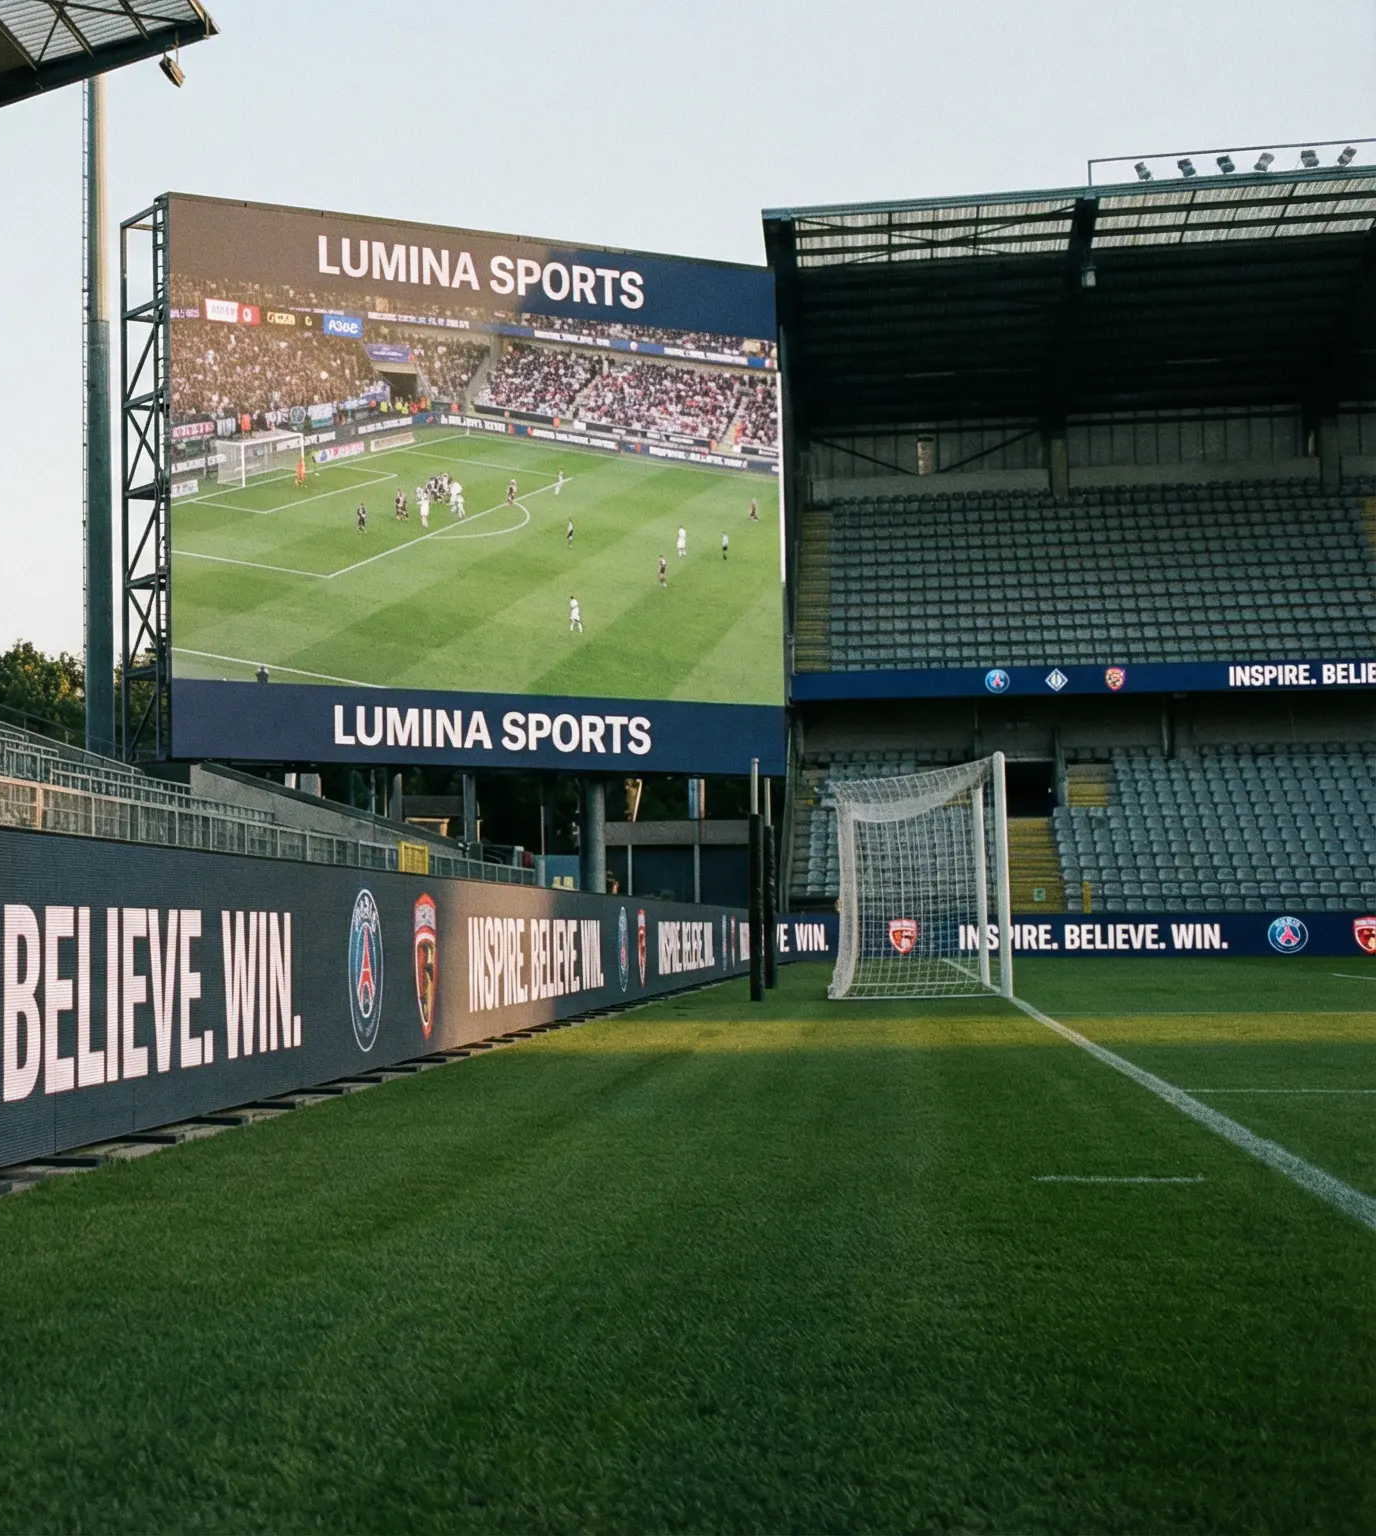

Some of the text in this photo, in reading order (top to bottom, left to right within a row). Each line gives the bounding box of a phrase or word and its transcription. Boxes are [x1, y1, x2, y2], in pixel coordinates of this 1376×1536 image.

[318, 235, 645, 310] LUMINA SPORTS
[1228, 664, 1317, 686] INSPIRE.
[334, 705, 652, 755] LUMINA SPORTS
[795, 923, 829, 953] WIN.
[1064, 923, 1166, 950] BELIEVE.
[1170, 923, 1229, 950] WIN.
[468, 916, 528, 1013] INSPIRE.
[530, 919, 580, 1002] BELIEVE.
[3, 904, 214, 1102] BELIEVE.
[221, 911, 302, 1060] WIN.
